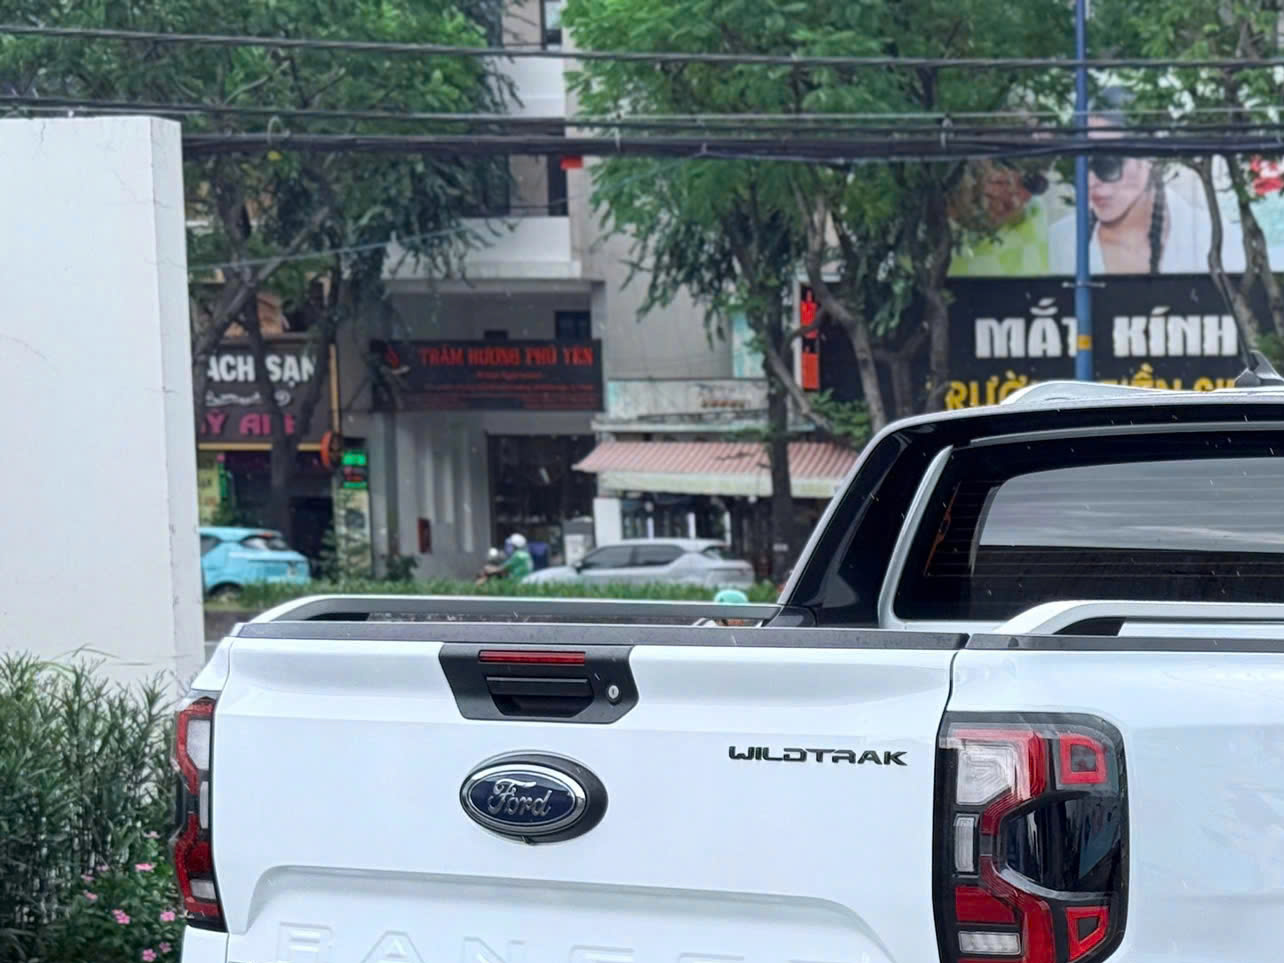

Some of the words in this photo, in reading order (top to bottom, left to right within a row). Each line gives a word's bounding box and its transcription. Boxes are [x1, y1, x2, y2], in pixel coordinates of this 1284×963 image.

[1112, 306, 1239, 357] KÍNH
[728, 745, 908, 767] WILDTRAK
[487, 777, 552, 819] Ford
